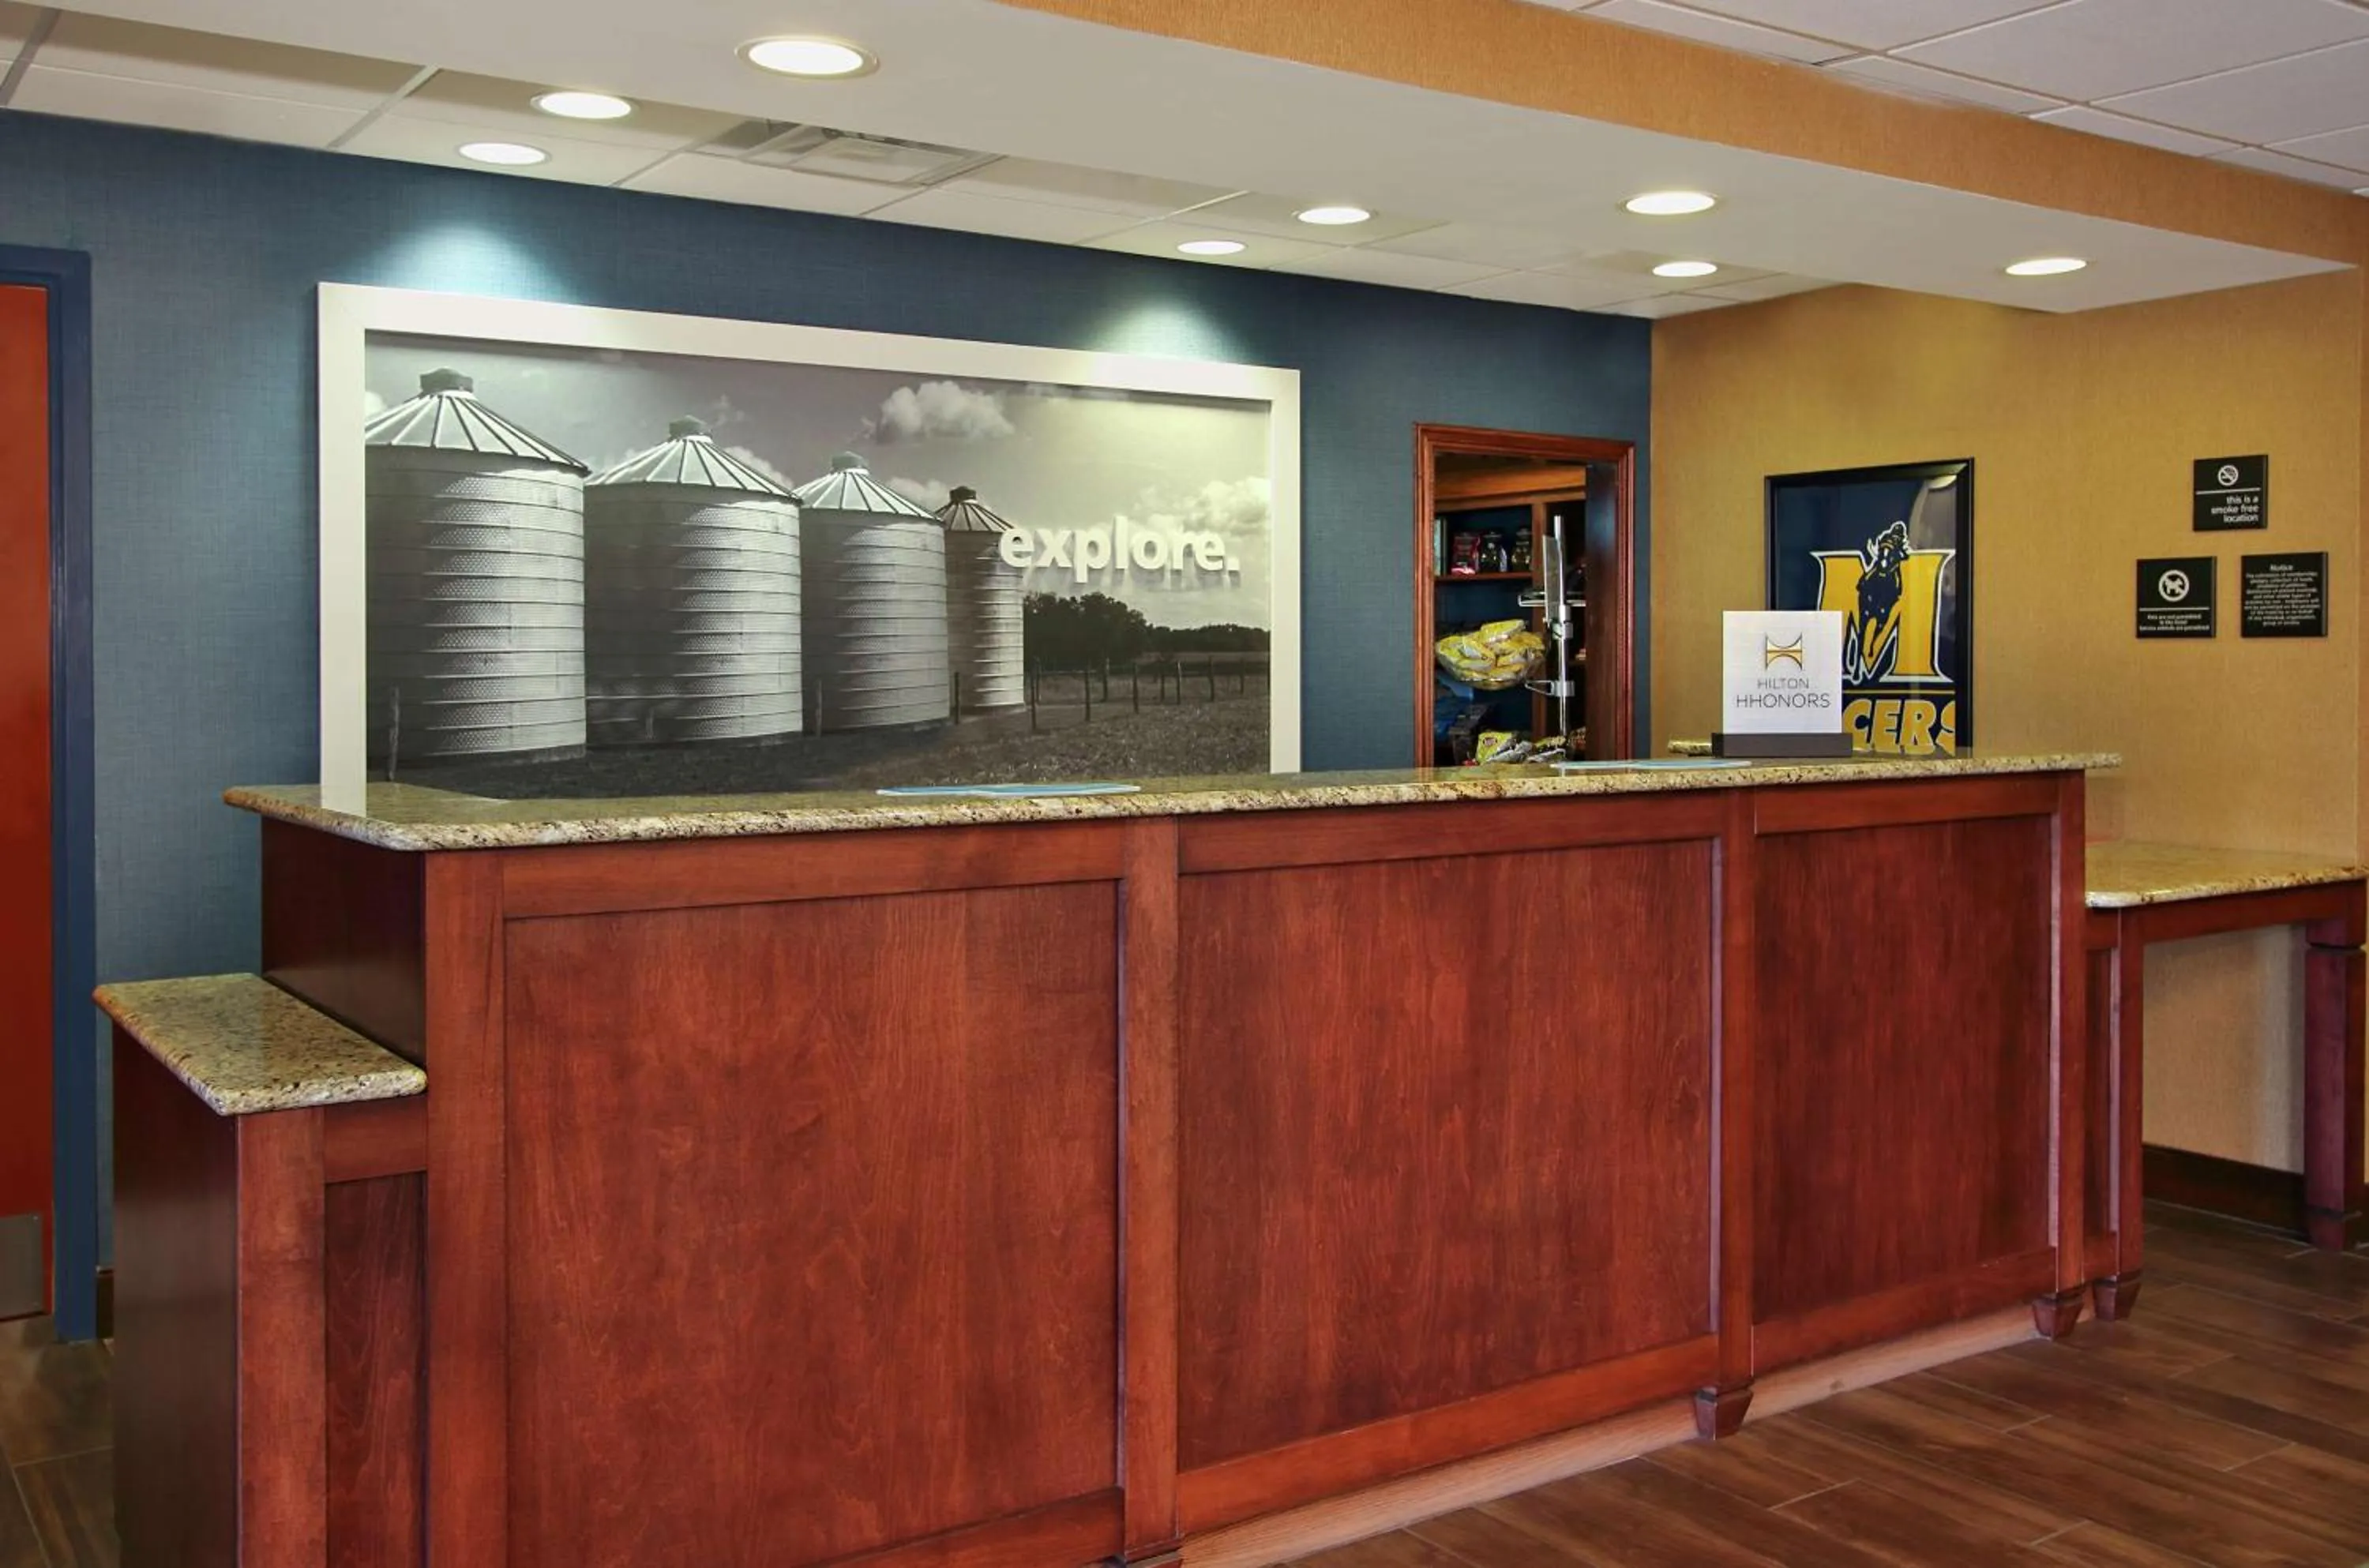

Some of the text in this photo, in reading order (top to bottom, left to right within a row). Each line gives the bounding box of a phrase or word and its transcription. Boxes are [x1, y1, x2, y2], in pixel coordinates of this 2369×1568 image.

[2226, 496, 2242, 505] this
[2211, 505, 2239, 515] smoke
[2223, 514, 2258, 523] location
[1000, 516, 1240, 583] explore.
[1757, 677, 1810, 689] HILTON
[1736, 692, 1831, 708] HHONORS
[1842, 698, 1956, 756] CERS
